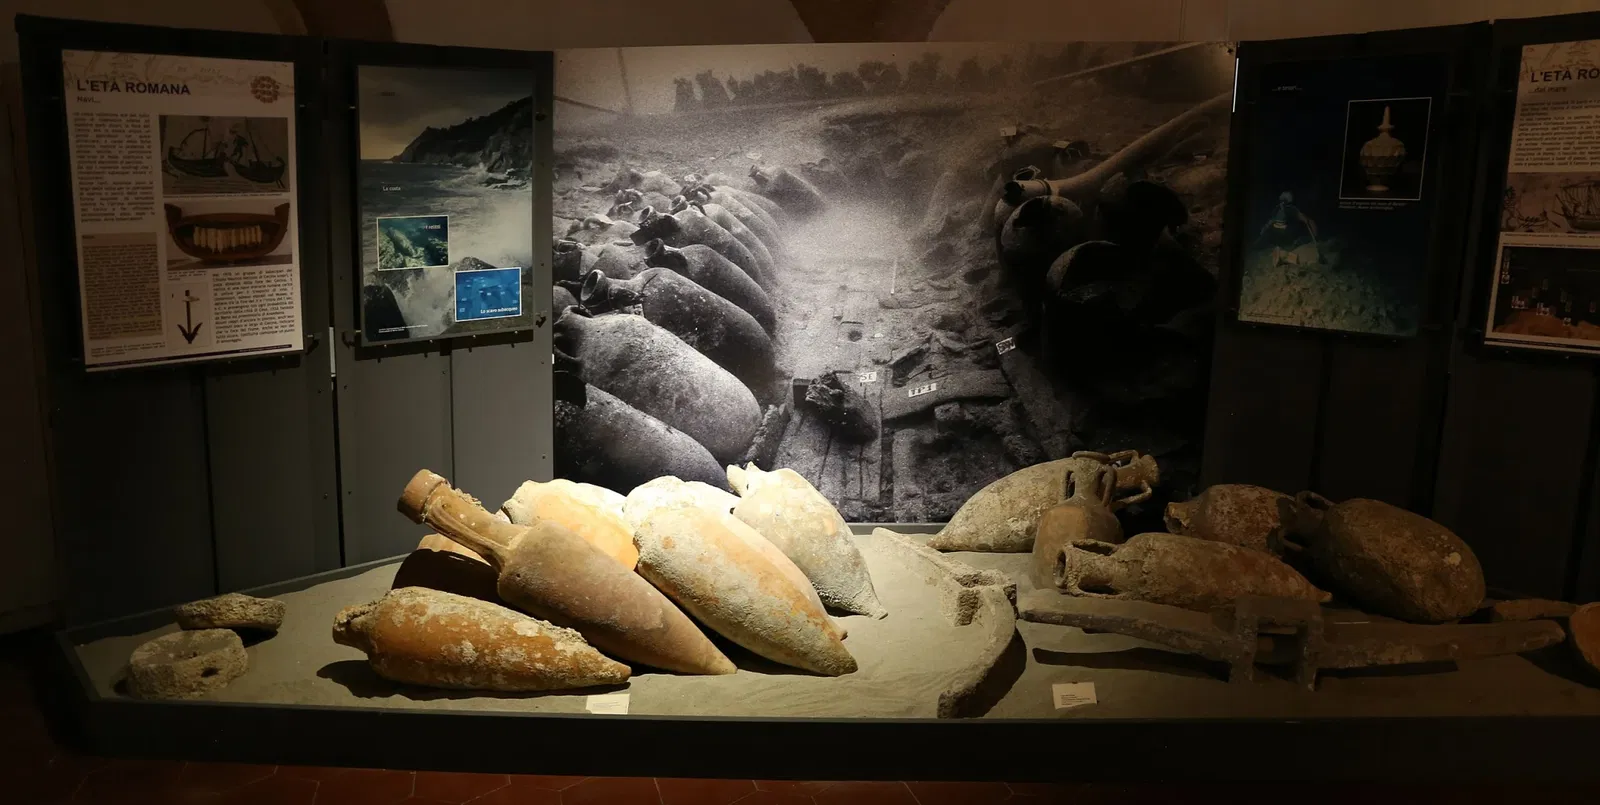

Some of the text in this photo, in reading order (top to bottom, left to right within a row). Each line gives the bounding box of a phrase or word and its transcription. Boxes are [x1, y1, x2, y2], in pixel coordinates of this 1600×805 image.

[1531, 67, 1572, 83] L'ETÀ
[77, 78, 191, 95] L'ETÀ ROMANA
